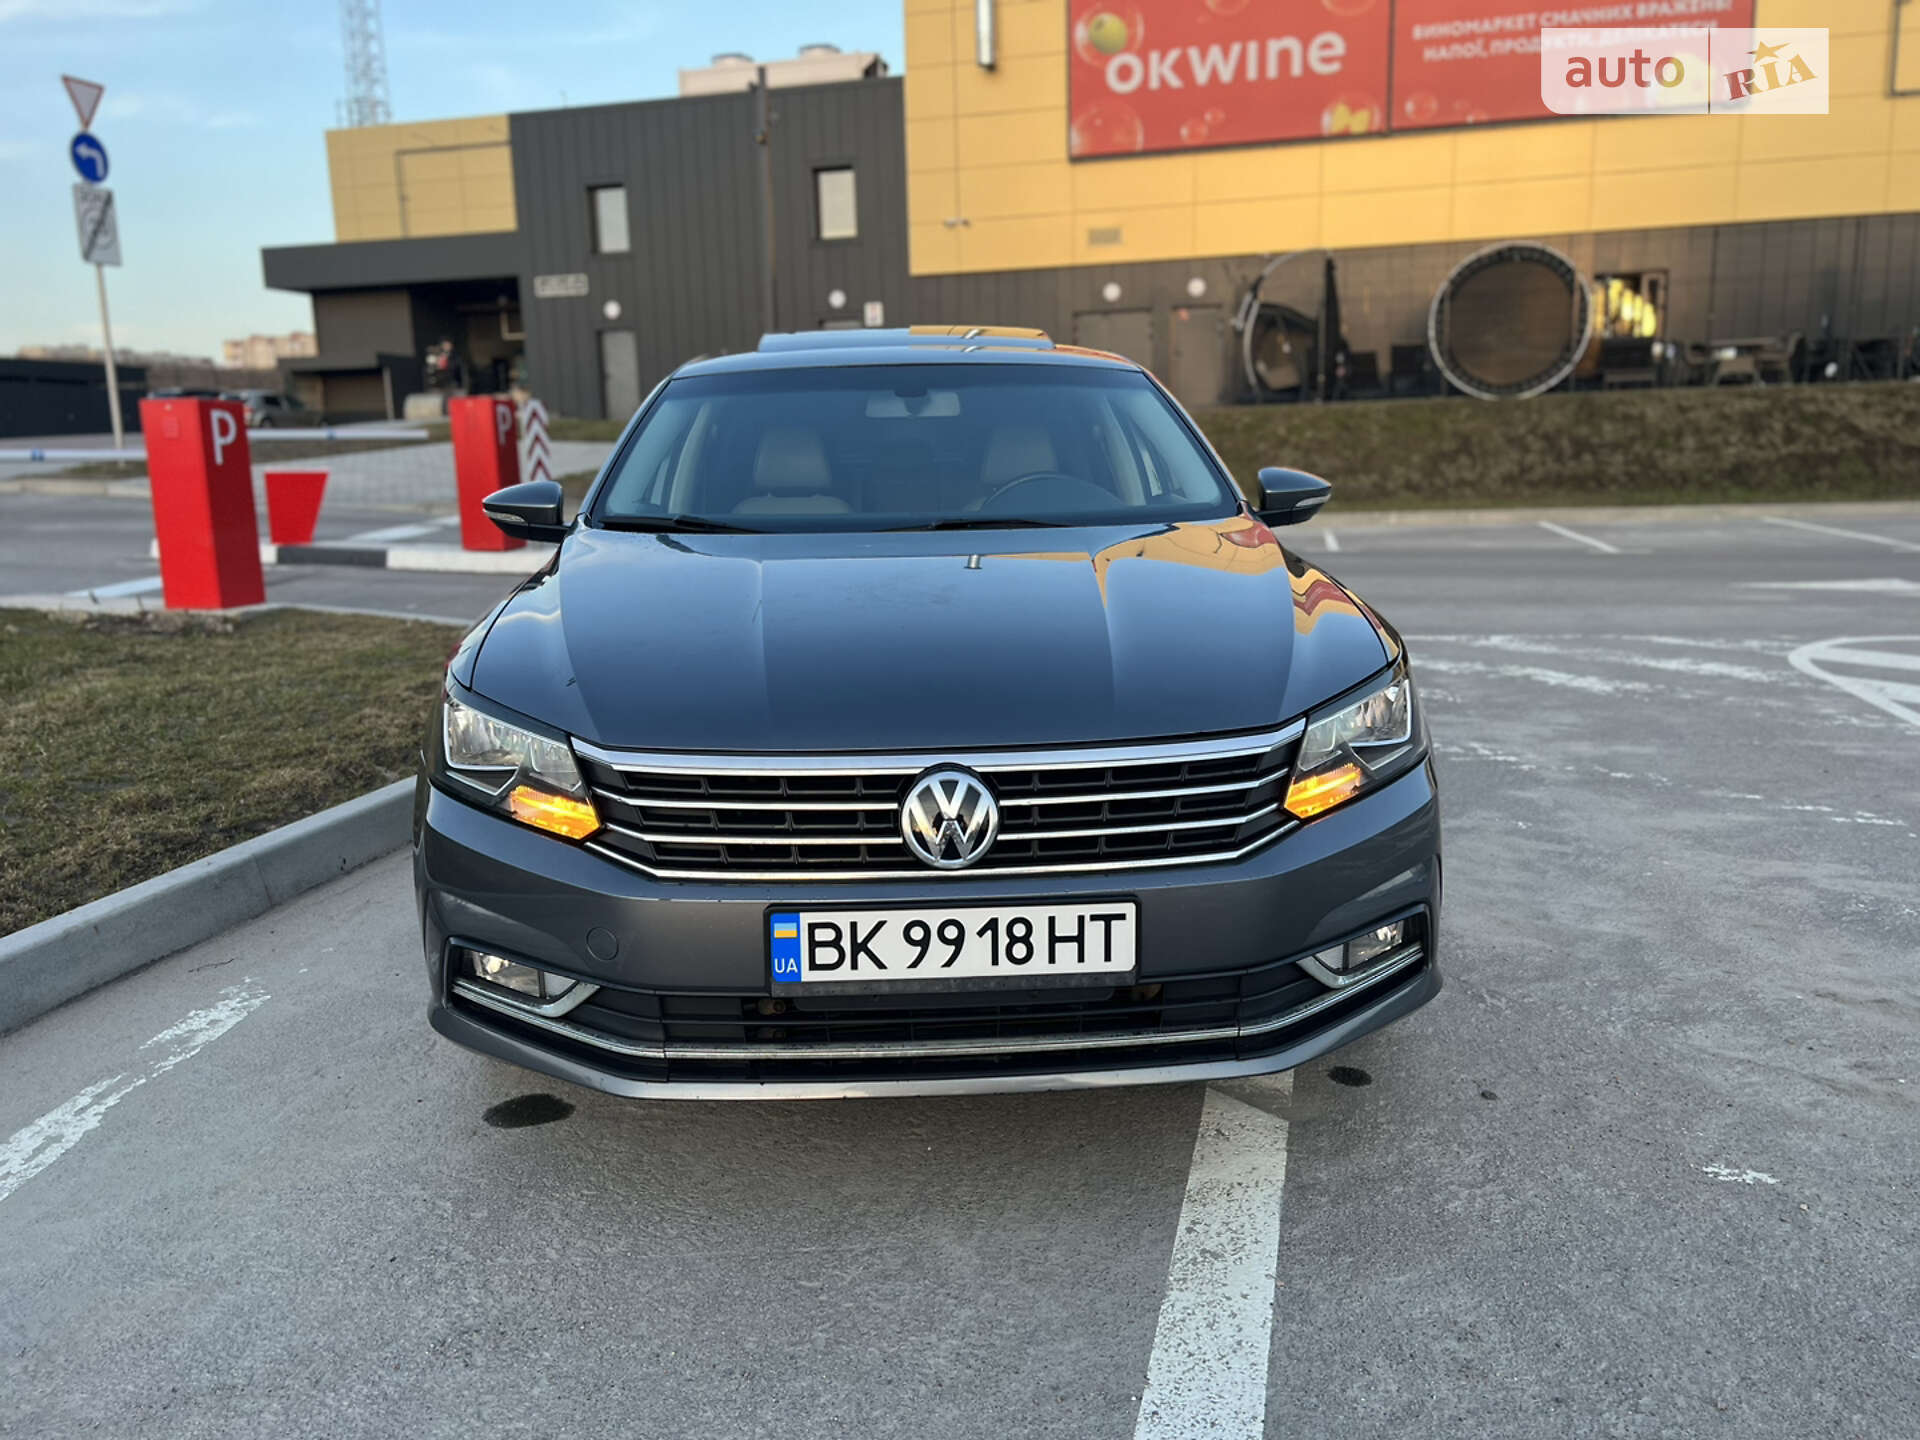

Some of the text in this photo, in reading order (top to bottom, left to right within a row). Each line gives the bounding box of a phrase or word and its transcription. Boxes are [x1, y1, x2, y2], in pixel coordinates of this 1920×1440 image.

[209, 408, 238, 465] P
[774, 958, 798, 974] UA
[807, 912, 1127, 972] BK 9918 HT
